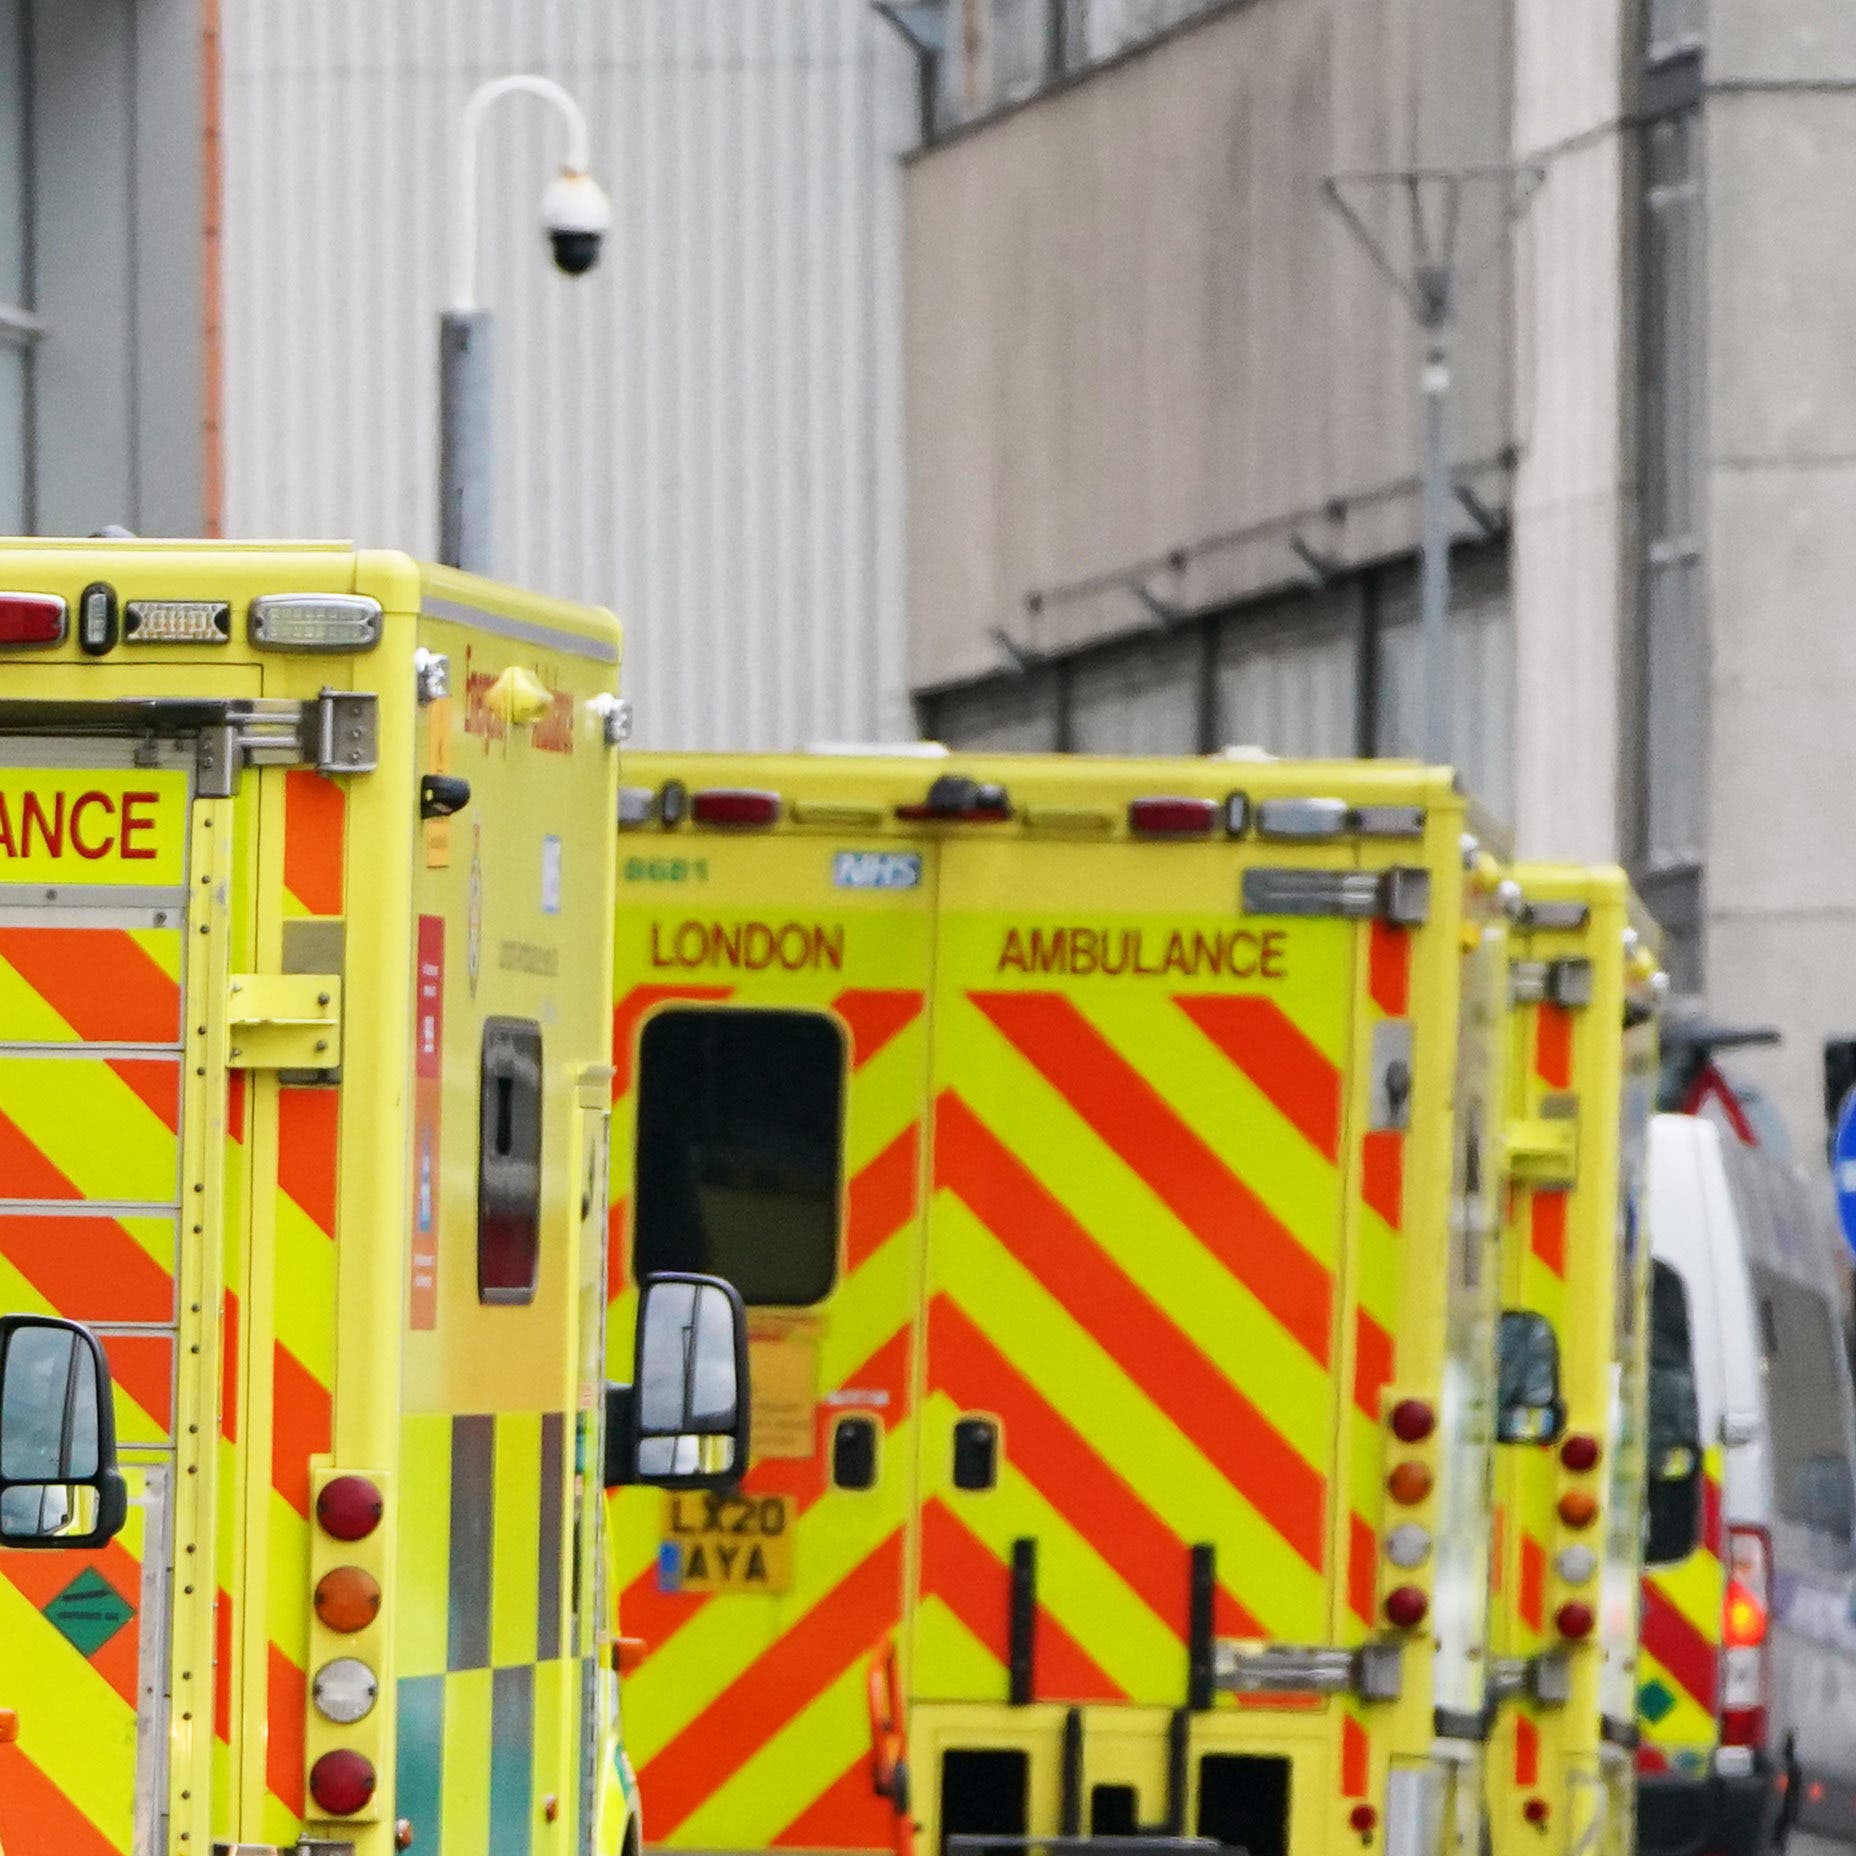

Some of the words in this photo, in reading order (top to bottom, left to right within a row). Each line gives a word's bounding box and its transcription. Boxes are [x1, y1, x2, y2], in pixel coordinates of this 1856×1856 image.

[651, 920, 845, 970] LONDON
[998, 927, 1288, 979] AMBULANCE
[686, 1543, 767, 1581] AYA
